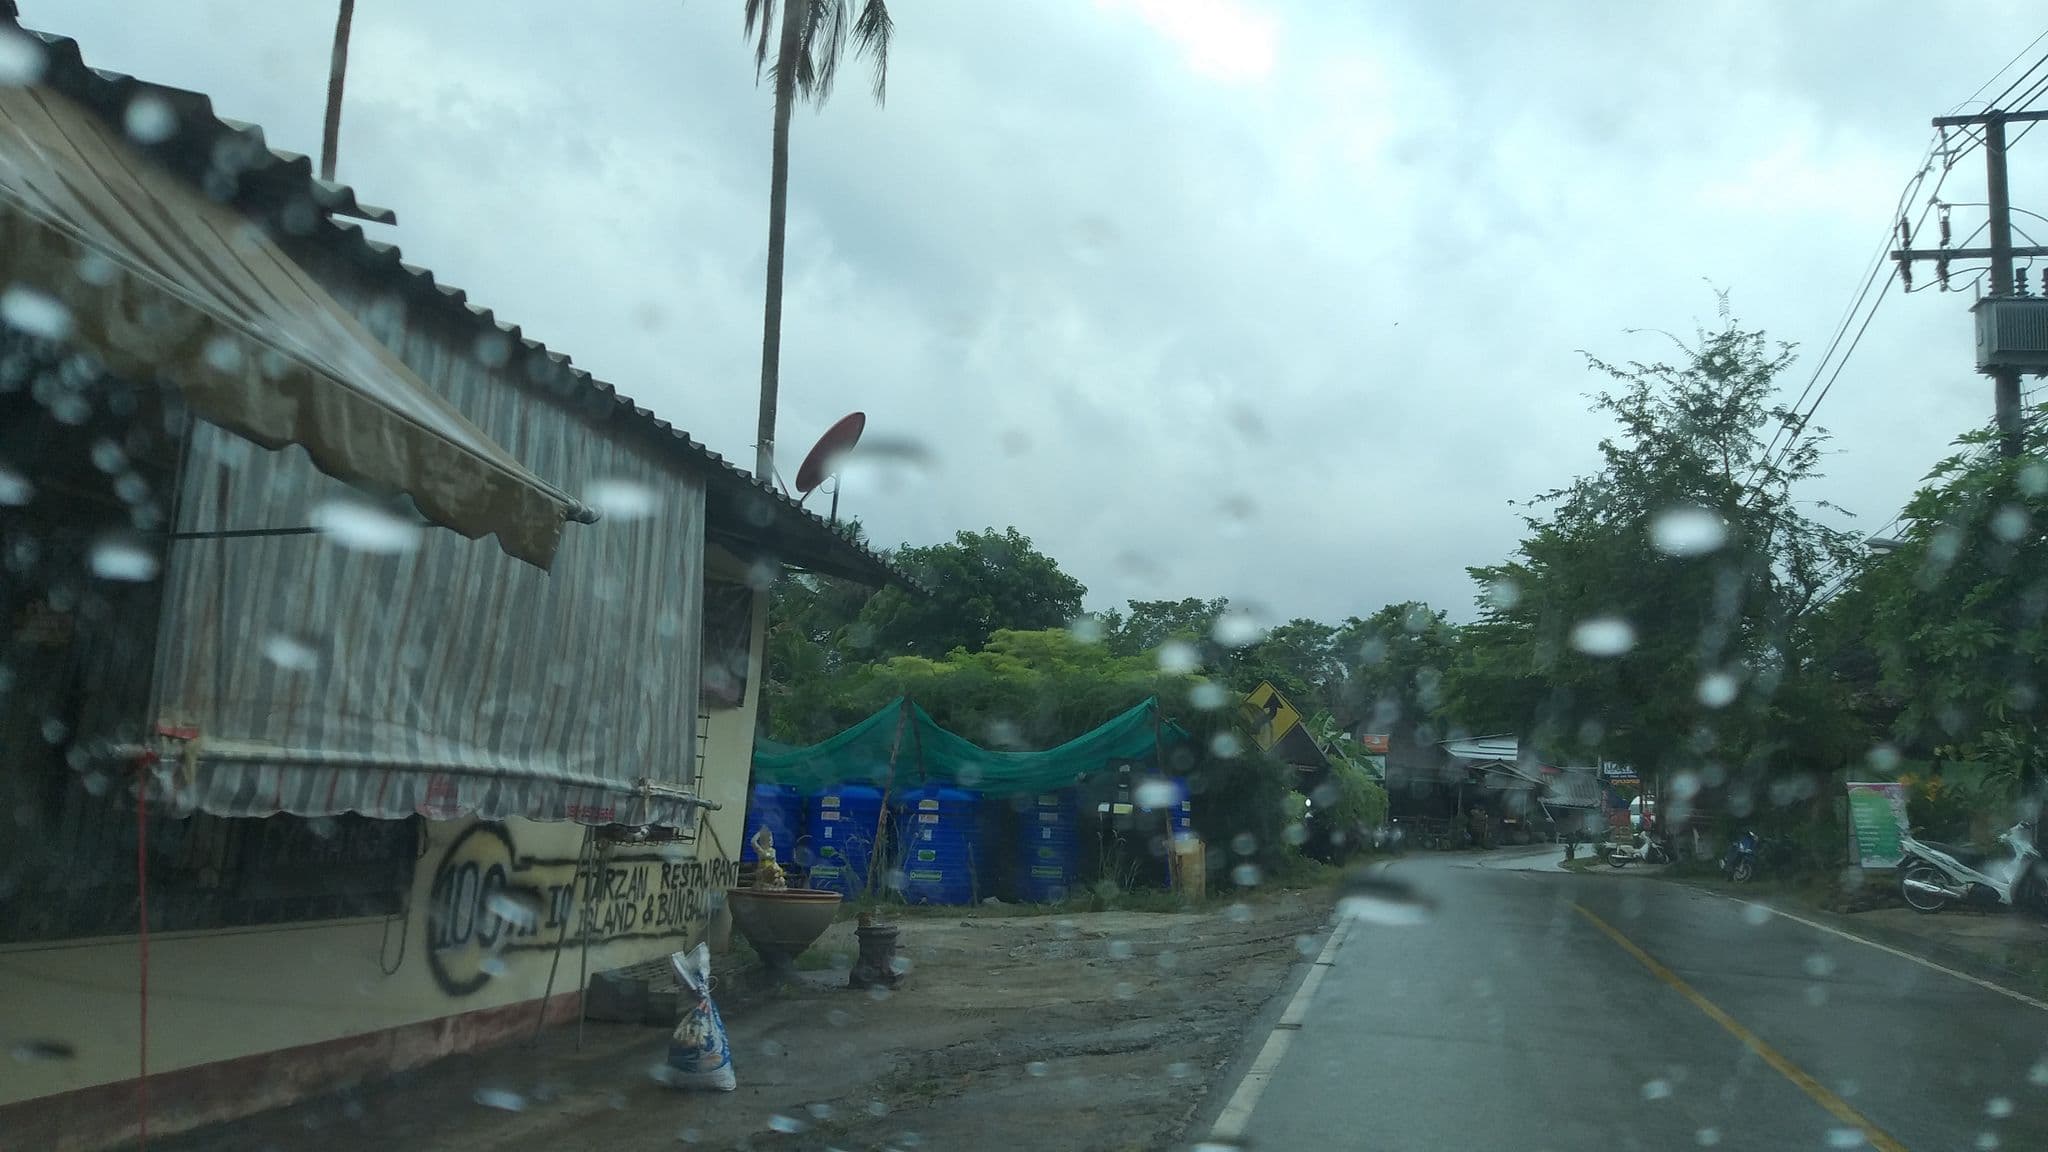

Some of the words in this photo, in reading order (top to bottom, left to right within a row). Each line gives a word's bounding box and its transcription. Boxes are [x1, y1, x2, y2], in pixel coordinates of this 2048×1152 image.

[577, 867, 649, 903] TARZAN
[660, 857, 740, 892] RESTAURANT
[574, 900, 638, 938] ISLAND
[642, 893, 655, 926] &
